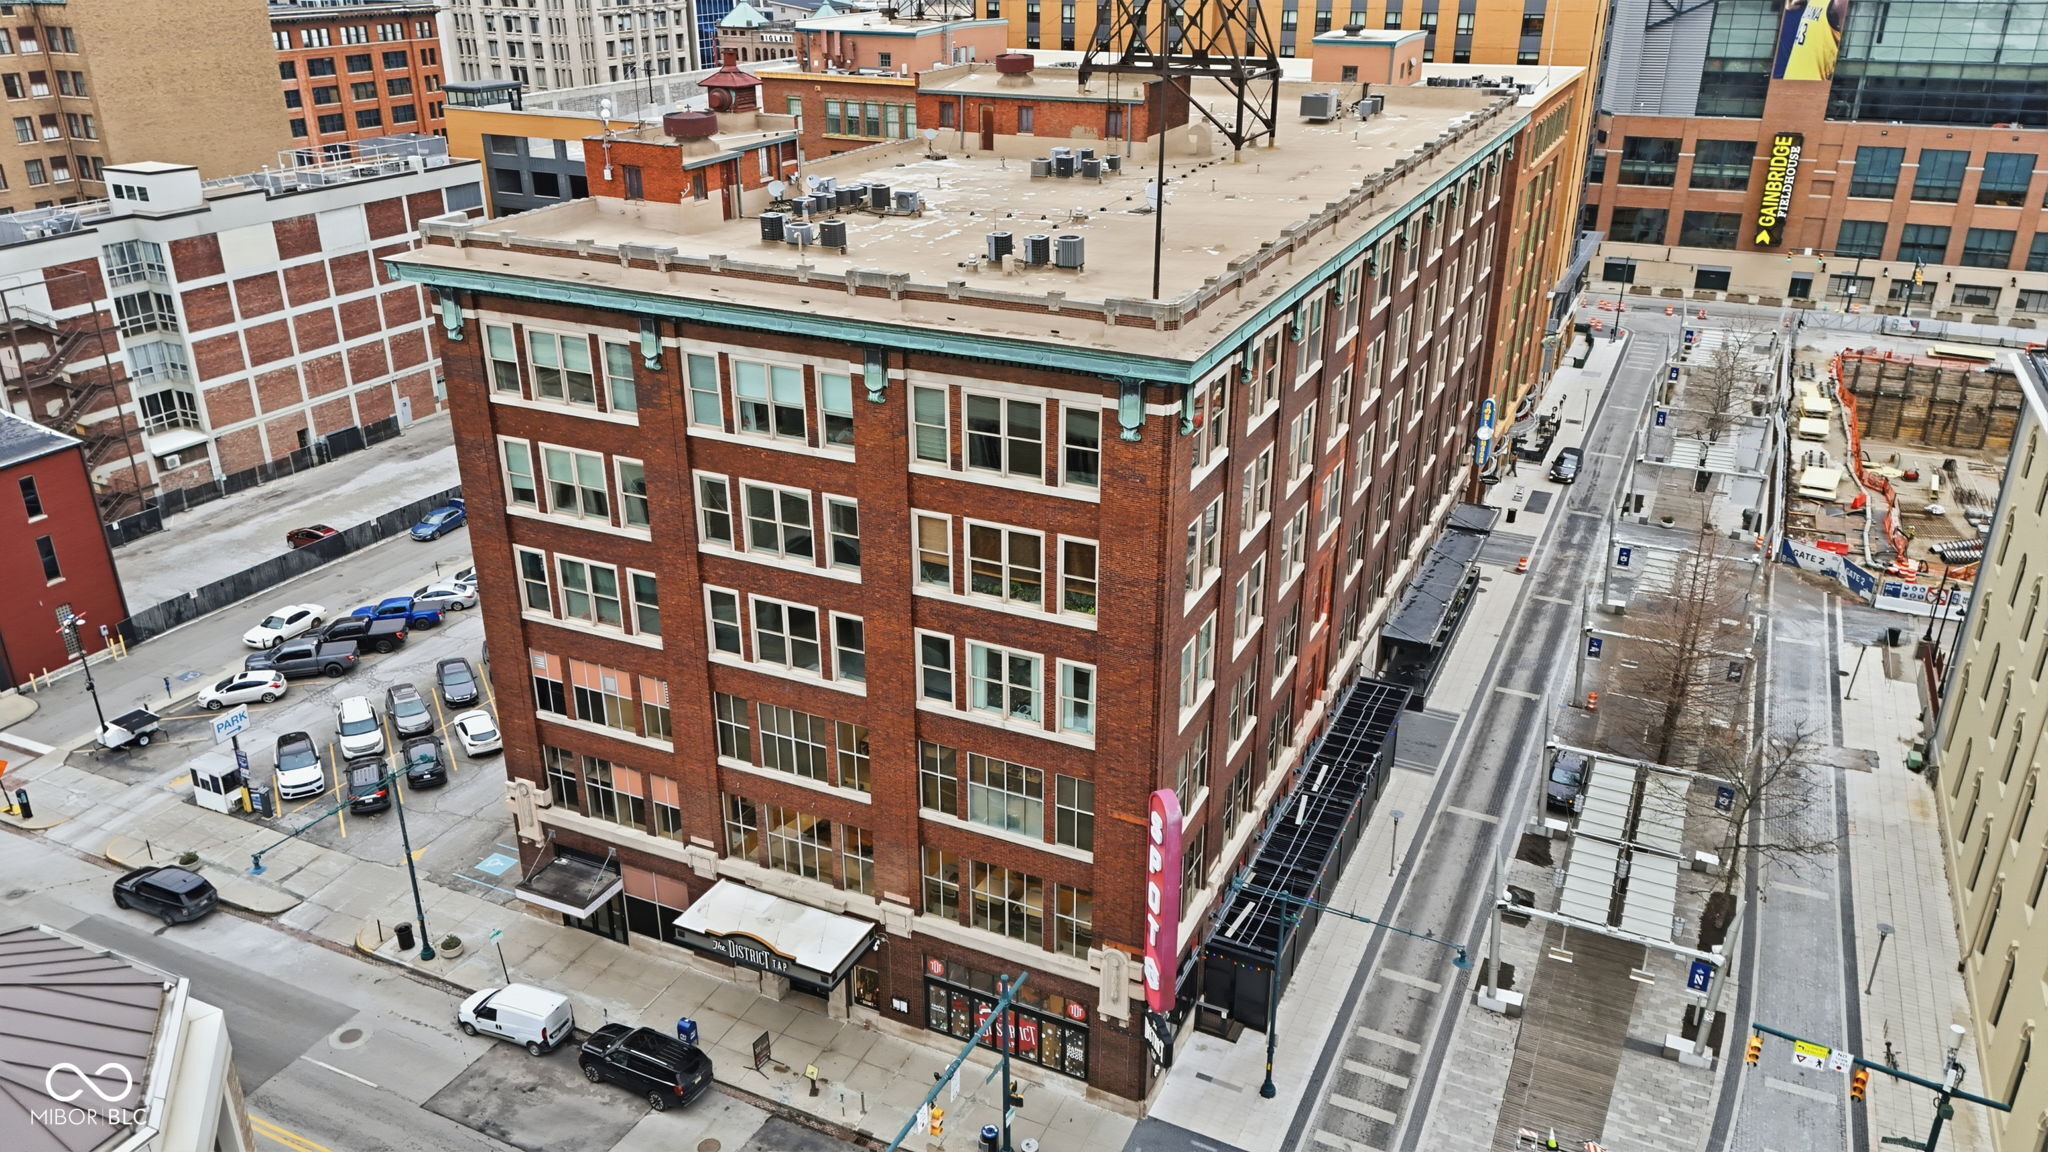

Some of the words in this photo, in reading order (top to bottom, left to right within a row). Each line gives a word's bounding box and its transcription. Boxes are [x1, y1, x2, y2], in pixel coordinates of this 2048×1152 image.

[760, 34, 792, 42] BIGLARI
[1758, 136, 1793, 227] GAINBRIDGE
[1777, 145, 1801, 218] FIELDHOUSE
[1793, 549, 1817, 563] GATE
[1818, 557, 1826, 566] 2
[1845, 567, 1860, 583] GATE
[1860, 577, 1866, 586] 2
[216, 710, 247, 733] PARK
[713, 940, 727, 952] The
[728, 940, 770, 969] DISTRICT
[772, 960, 787, 971] TAP
[979, 1017, 1036, 1045] DISRICT
